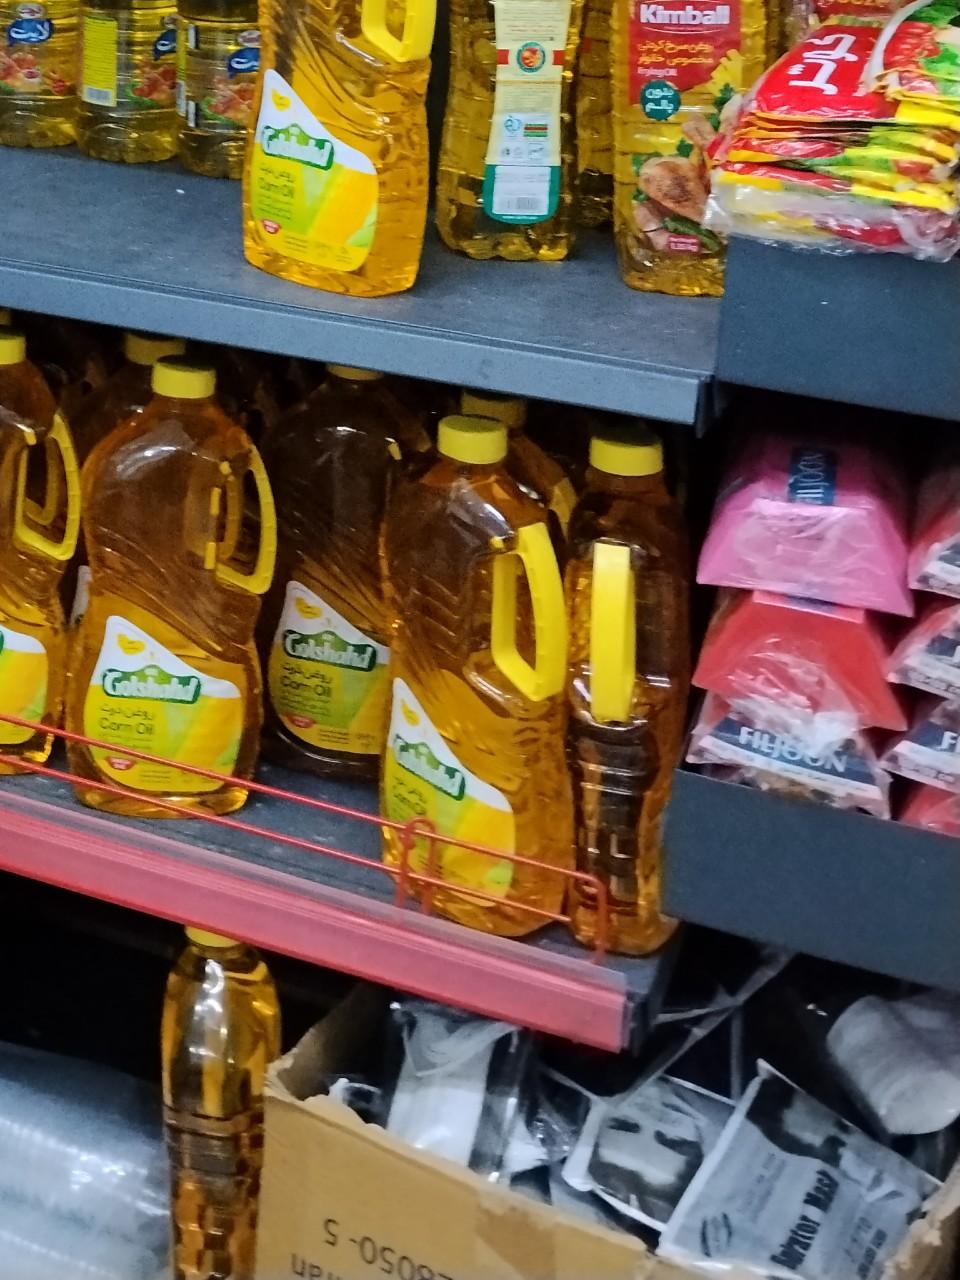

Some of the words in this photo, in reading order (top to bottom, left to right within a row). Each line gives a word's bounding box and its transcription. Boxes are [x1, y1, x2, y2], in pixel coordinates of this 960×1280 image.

[640, 4, 730, 25] Kimball
[281, 676, 313, 690] Corn
[314, 683, 332, 697] Oil
[99, 717, 133, 731] Corn
[135, 722, 155, 735] Oil
